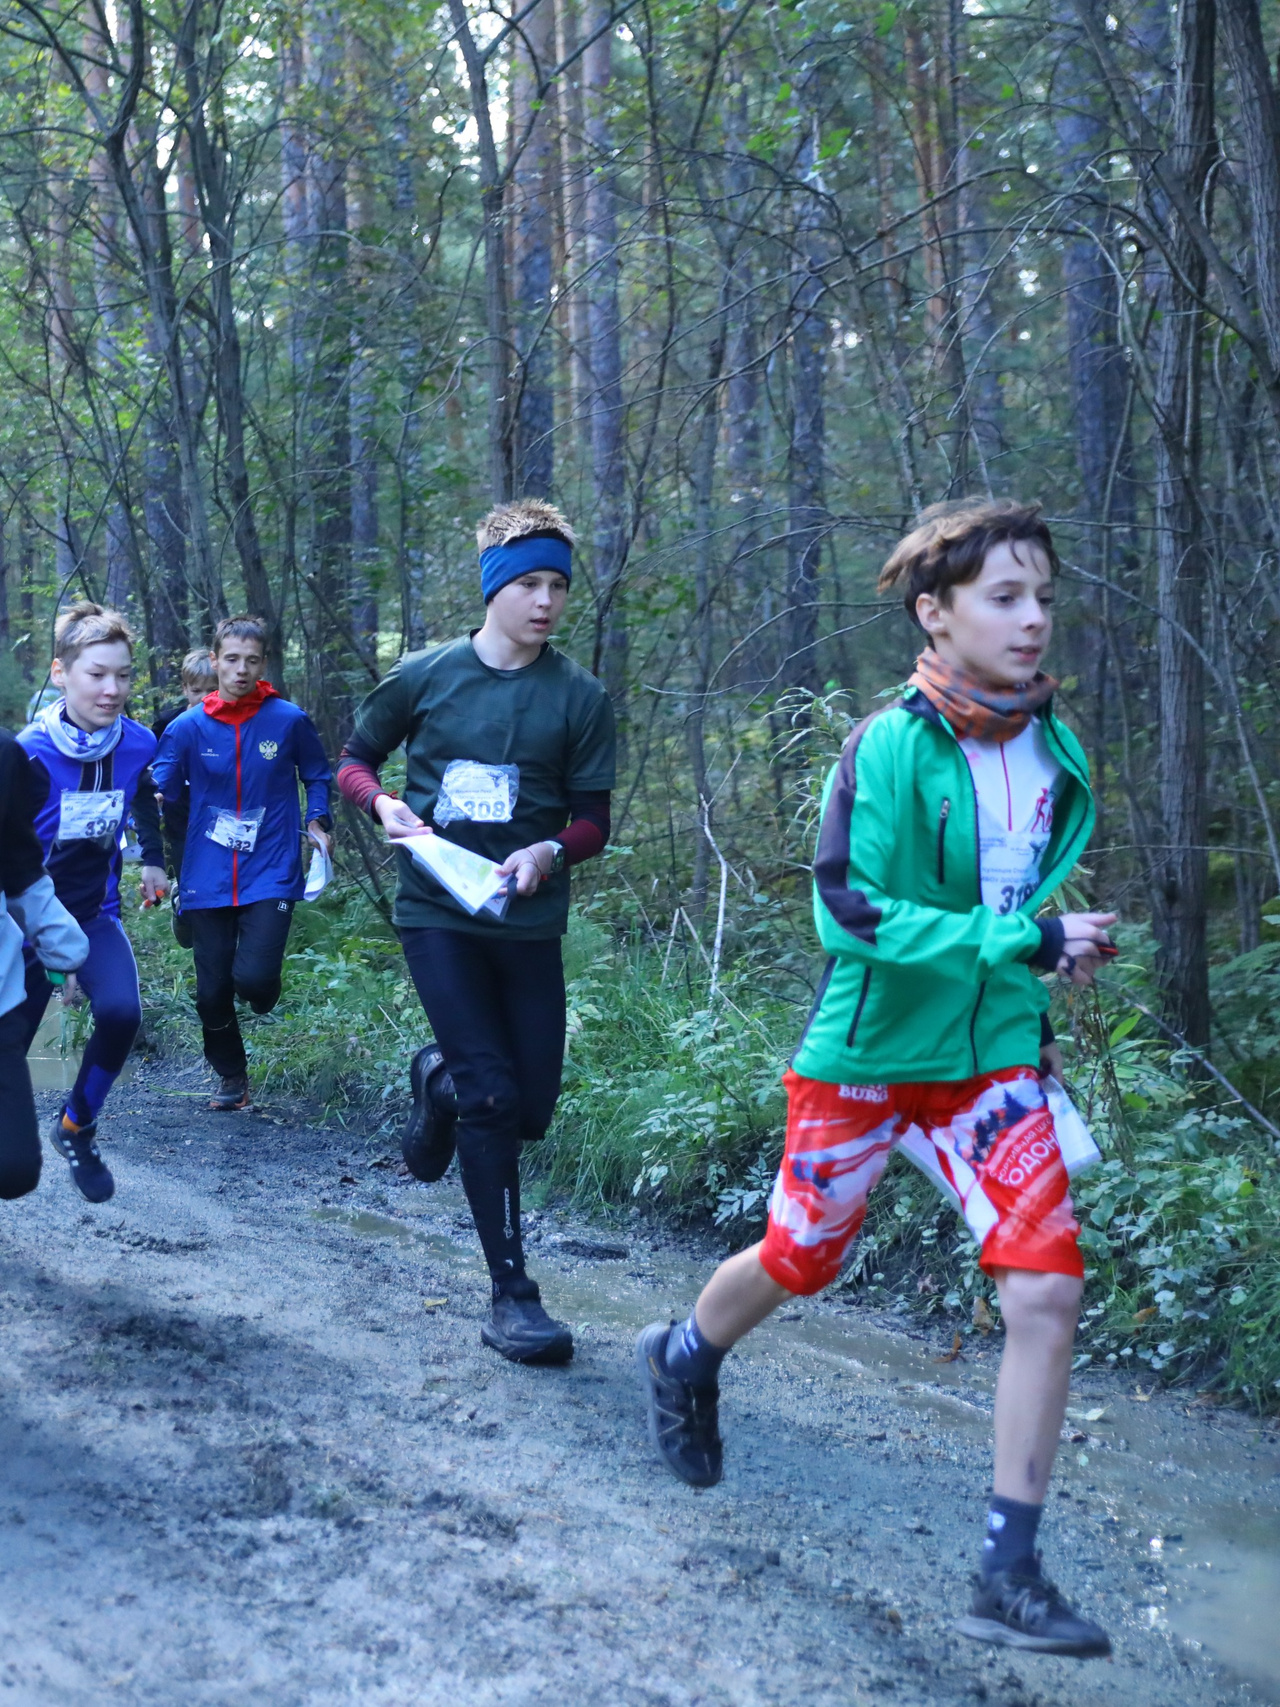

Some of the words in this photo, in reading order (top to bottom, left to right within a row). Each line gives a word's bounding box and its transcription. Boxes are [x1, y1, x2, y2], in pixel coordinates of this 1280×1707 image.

[464, 801, 505, 818] 308
[85, 819, 118, 836] 330
[226, 837, 251, 851] 332
[1004, 1130, 1060, 1185] ОДОН
